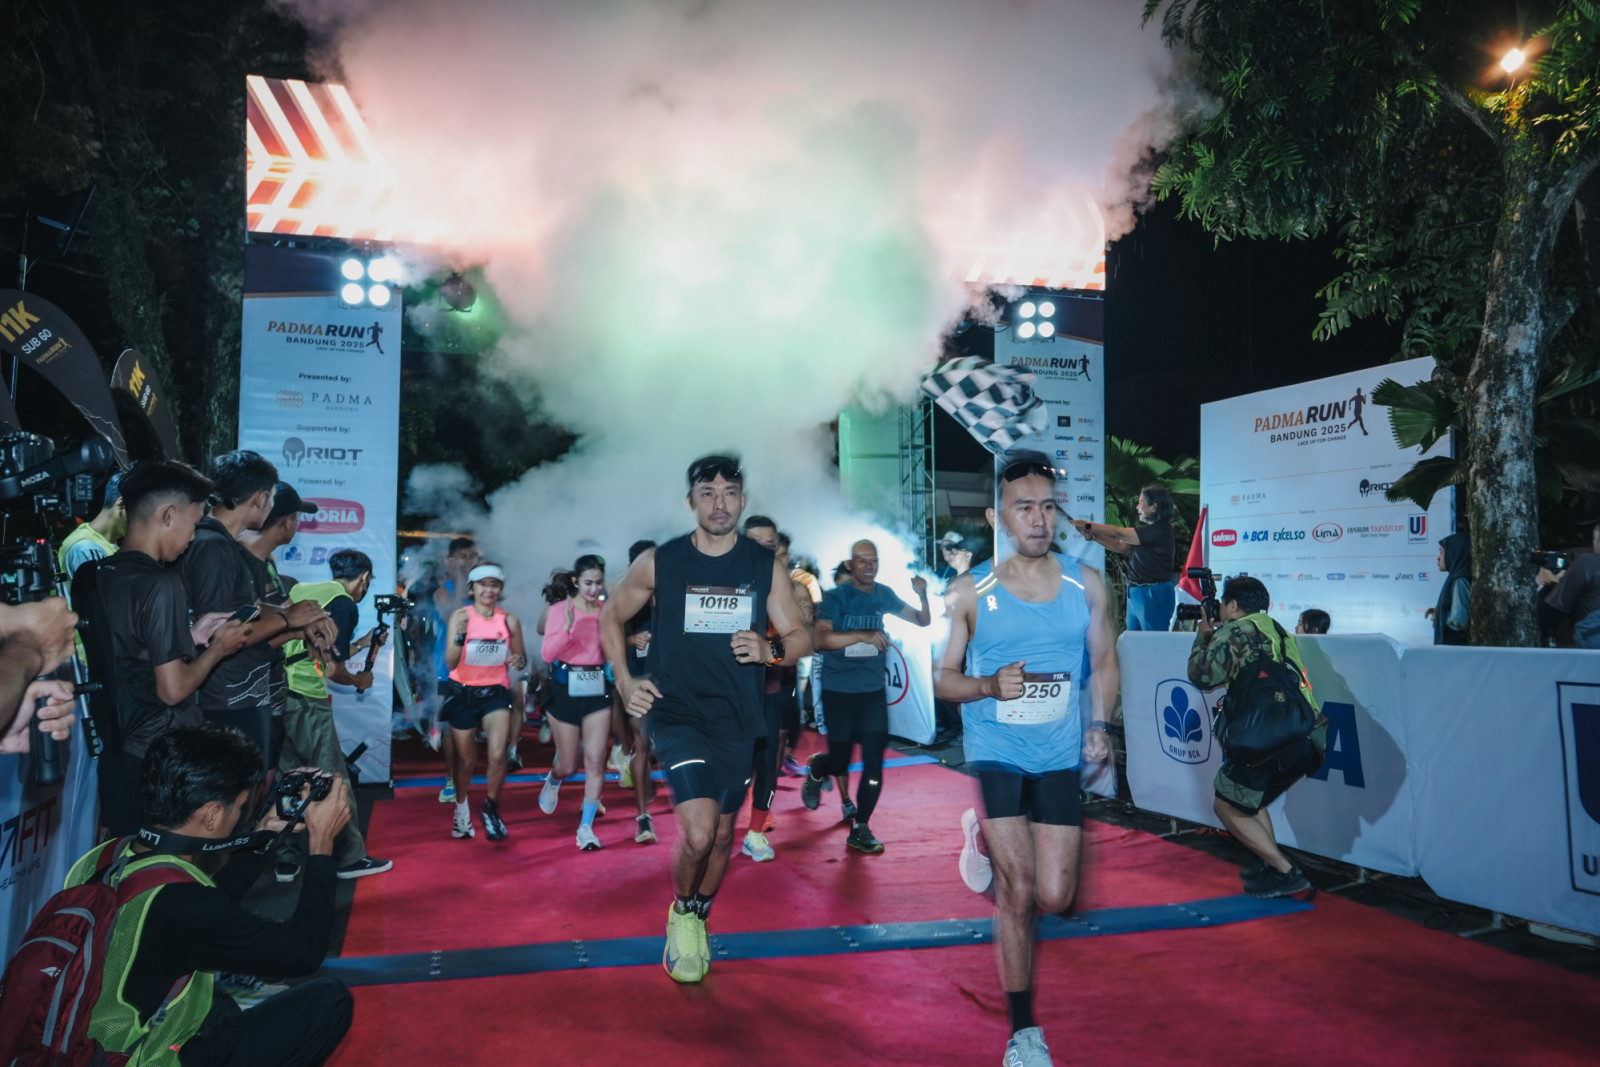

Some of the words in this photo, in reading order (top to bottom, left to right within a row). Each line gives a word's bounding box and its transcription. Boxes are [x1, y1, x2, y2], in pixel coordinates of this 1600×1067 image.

[21, 337, 41, 355] SUB
[38, 328, 52, 341] 60
[286, 336, 337, 346] BANDUNG
[340, 340, 365, 349] 2025
[299, 373, 338, 382] Presented
[340, 374, 352, 383] by:
[312, 392, 372, 405] PADMA
[297, 424, 338, 433] Supported
[339, 425, 351, 433] by:
[1270, 428, 1317, 443] BANDUNG
[1321, 423, 1347, 435] 2025
[307, 447, 363, 461] RIOT
[20, 471, 50, 488] MOZA
[298, 478, 333, 486] Powered
[334, 478, 346, 487] by:
[1242, 492, 1266, 501] PADMA
[300, 509, 359, 524] AVORIA
[1251, 530, 1269, 542] BCA
[1273, 528, 1306, 542] EXCELSO
[309, 546, 358, 565] BC
[699, 596, 738, 610] 10118
[475, 645, 498, 653] 10181
[1169, 744, 1187, 758] GRUP
[1188, 747, 1201, 759] BCA
